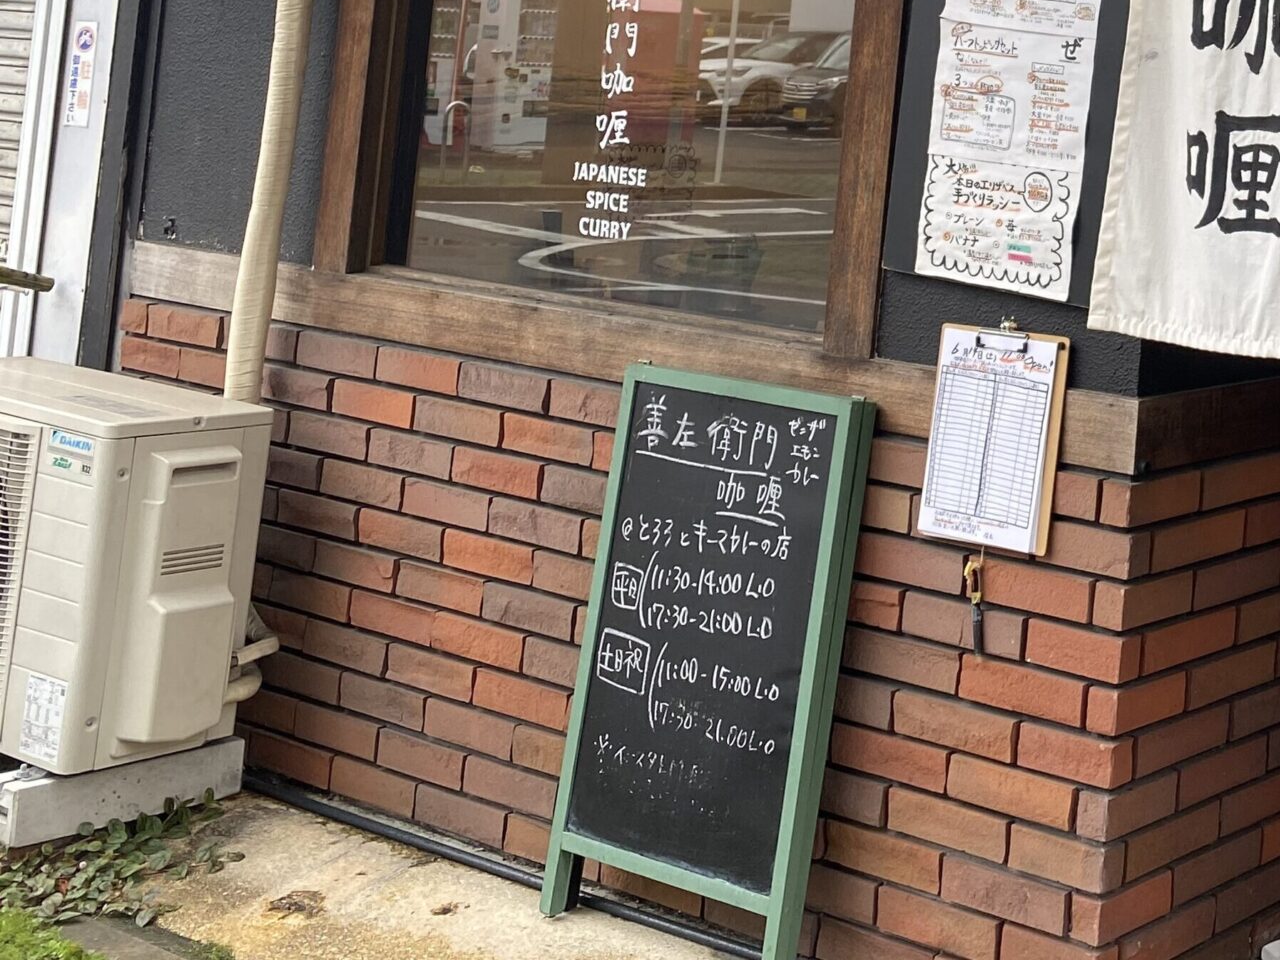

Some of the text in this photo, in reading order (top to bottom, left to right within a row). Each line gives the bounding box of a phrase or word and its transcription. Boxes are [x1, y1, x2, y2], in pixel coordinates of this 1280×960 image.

[1060, 36, 1085, 61] ぜ
[572, 161, 647, 187] JAPANESE
[585, 190, 629, 213] SPICE
[578, 216, 631, 240] CURRY
[59, 435, 92, 452] DAIKIN
[634, 392, 778, 471] 善左衛門
